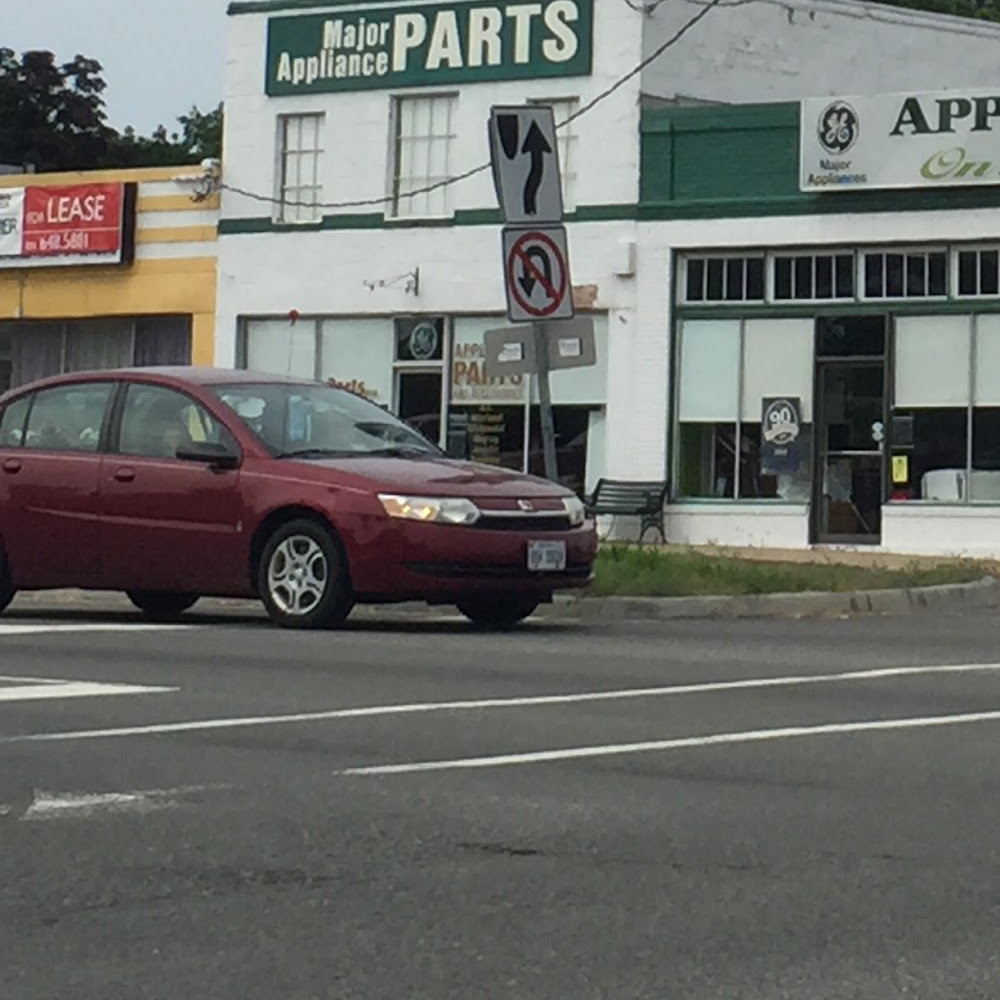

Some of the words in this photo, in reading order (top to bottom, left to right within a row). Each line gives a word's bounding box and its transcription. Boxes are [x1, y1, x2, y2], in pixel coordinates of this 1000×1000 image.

[323, 17, 390, 51] Major
[392, 0, 579, 72] PARTS
[276, 49, 389, 85] Appliance
[920, 146, 992, 181] On
[47, 194, 105, 223] LEASE
